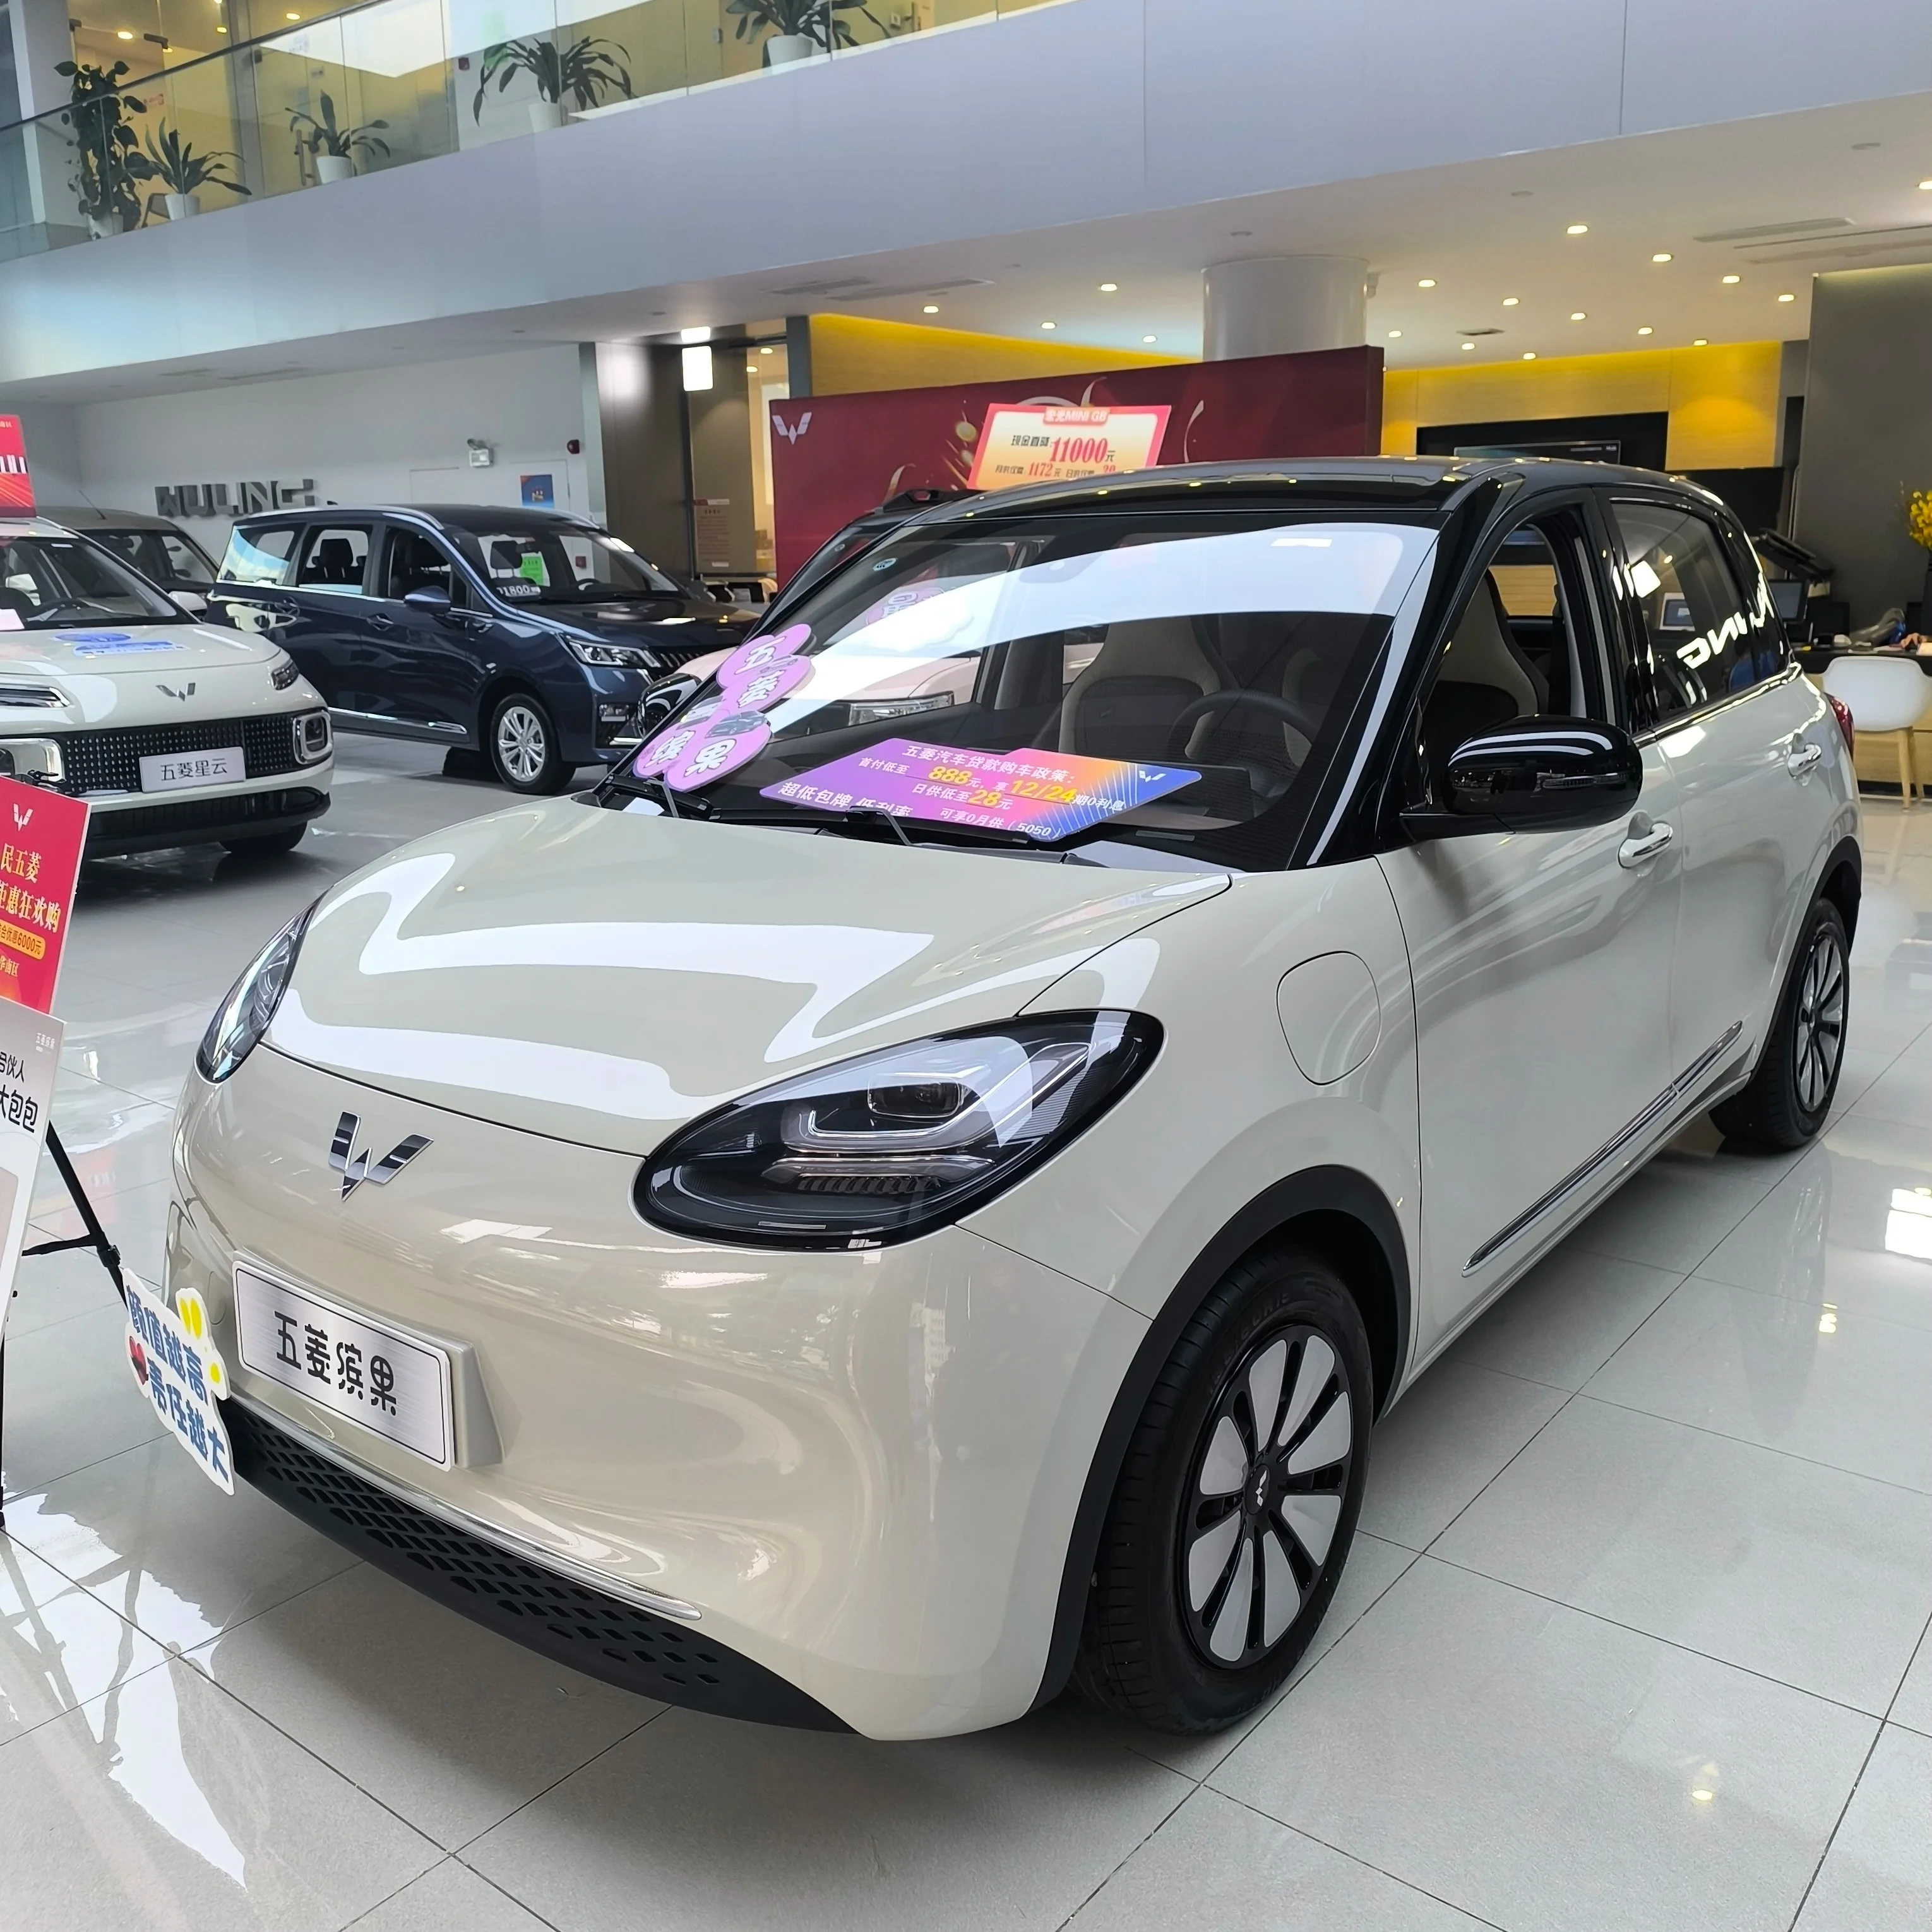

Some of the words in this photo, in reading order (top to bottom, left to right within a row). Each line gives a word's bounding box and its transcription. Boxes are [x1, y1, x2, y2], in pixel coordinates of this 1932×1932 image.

[160, 758, 227, 781] 五菱星云
[777, 782, 853, 808] 超低包牌
[273, 1309, 398, 1417] 五菱缤果
